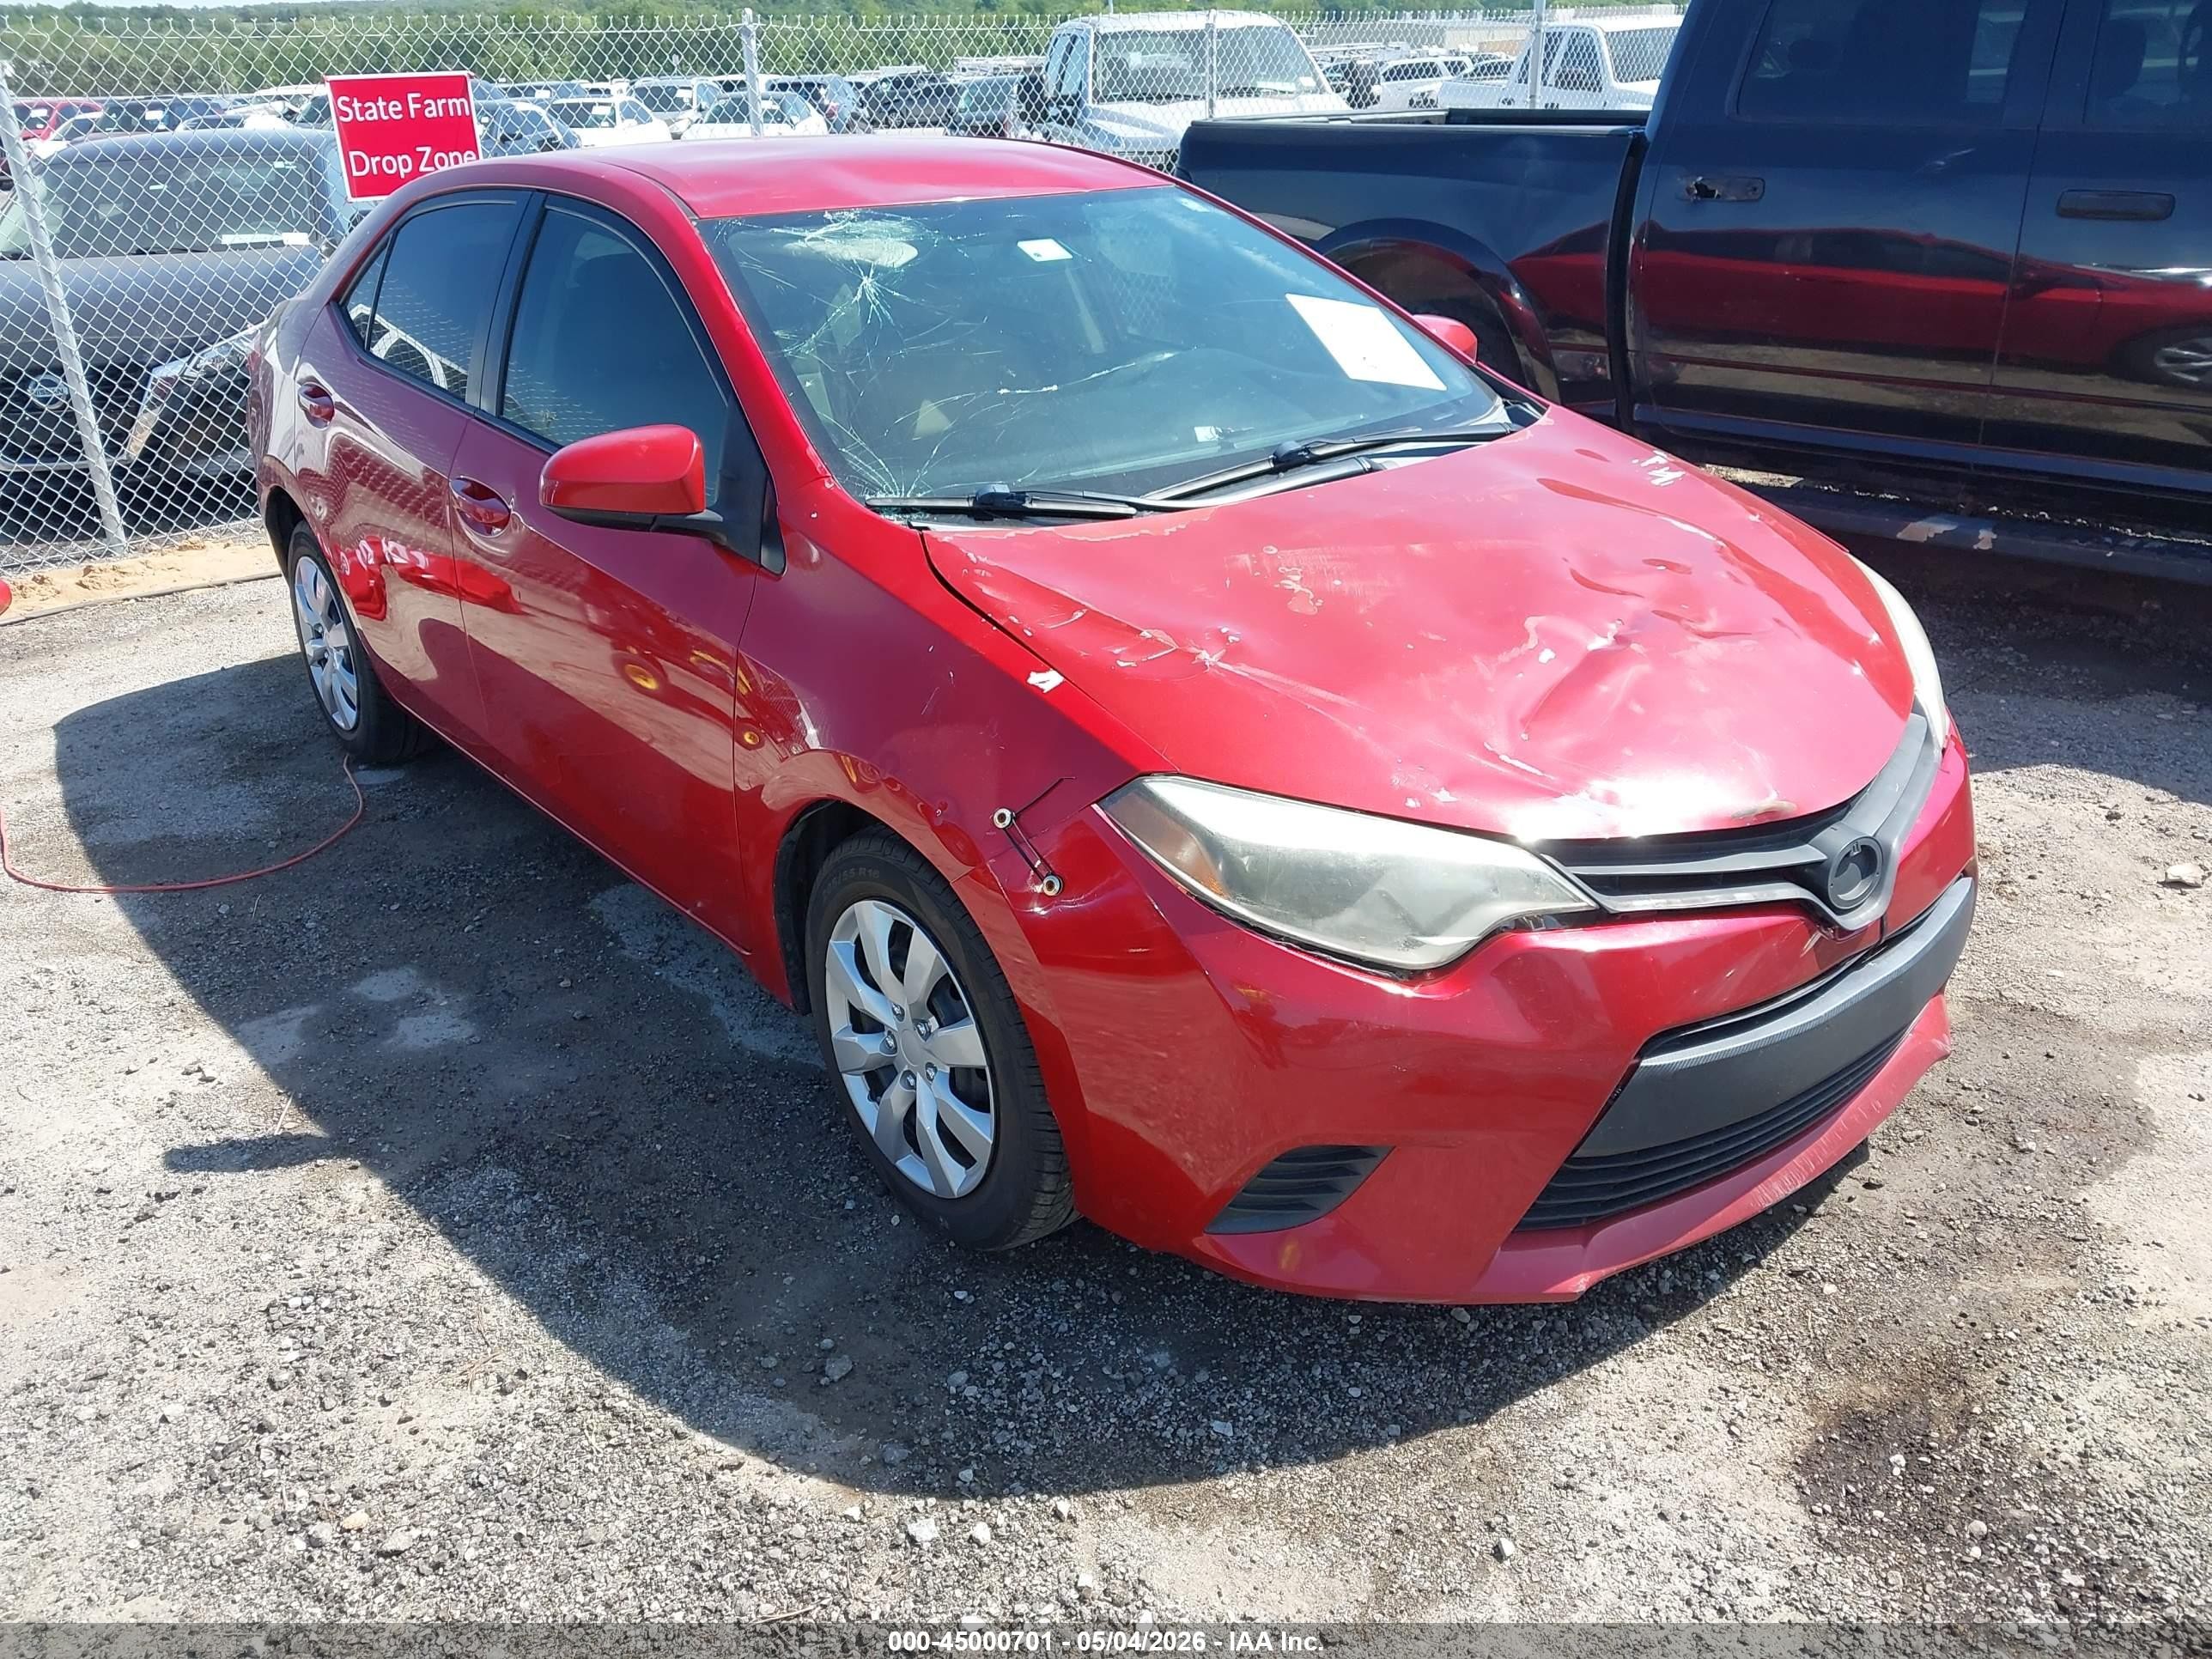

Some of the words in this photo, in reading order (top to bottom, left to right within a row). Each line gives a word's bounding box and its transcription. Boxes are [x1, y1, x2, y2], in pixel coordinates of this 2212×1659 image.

[337, 95, 403, 123] State
[407, 93, 470, 118] Farm
[349, 150, 412, 179] Drop
[416, 146, 477, 173] Zone
